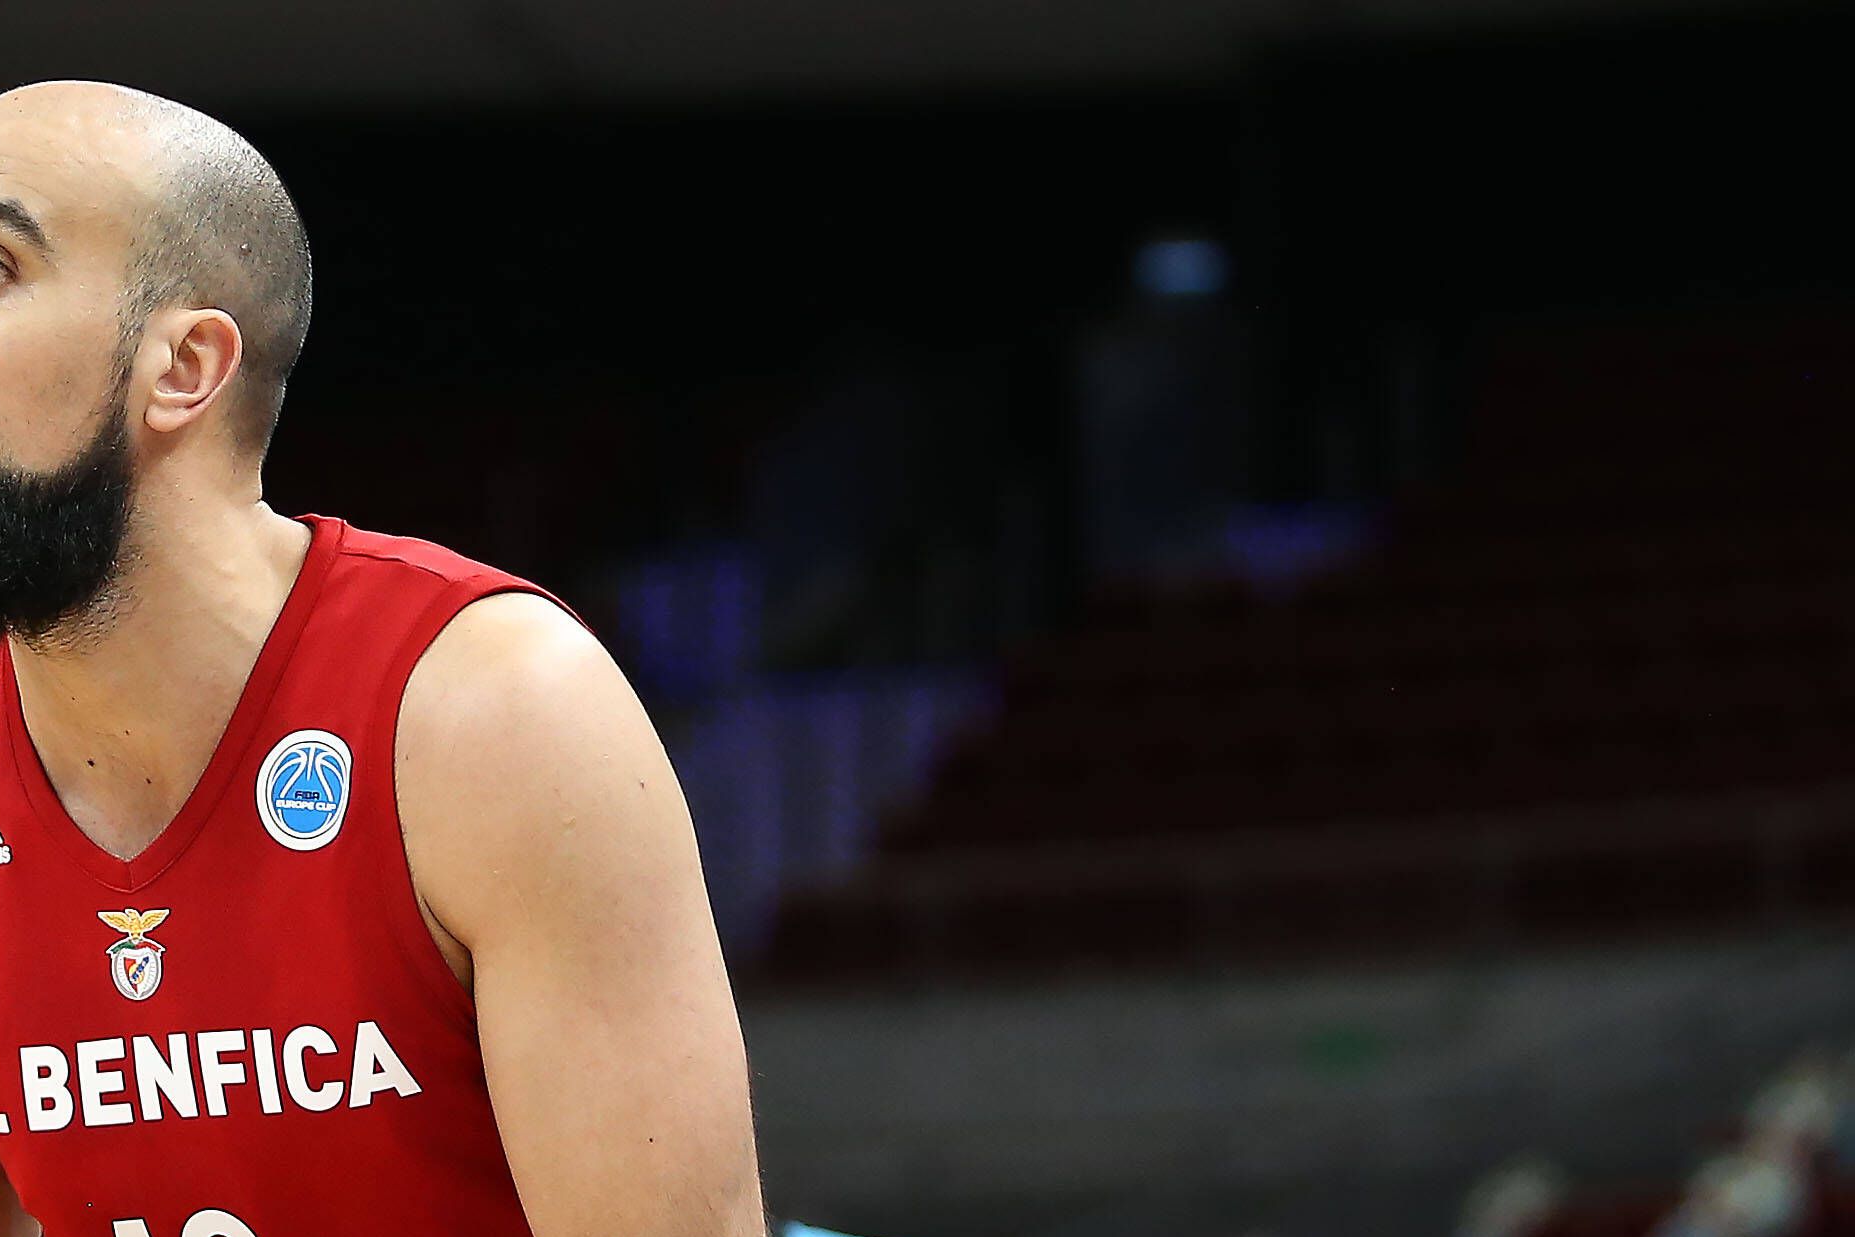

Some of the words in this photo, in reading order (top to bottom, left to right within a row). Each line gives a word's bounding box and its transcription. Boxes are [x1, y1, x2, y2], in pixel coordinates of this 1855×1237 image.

[275, 799, 314, 811] EUROPE
[315, 801, 337, 812] CUP
[19, 1020, 423, 1132] BENFICA
